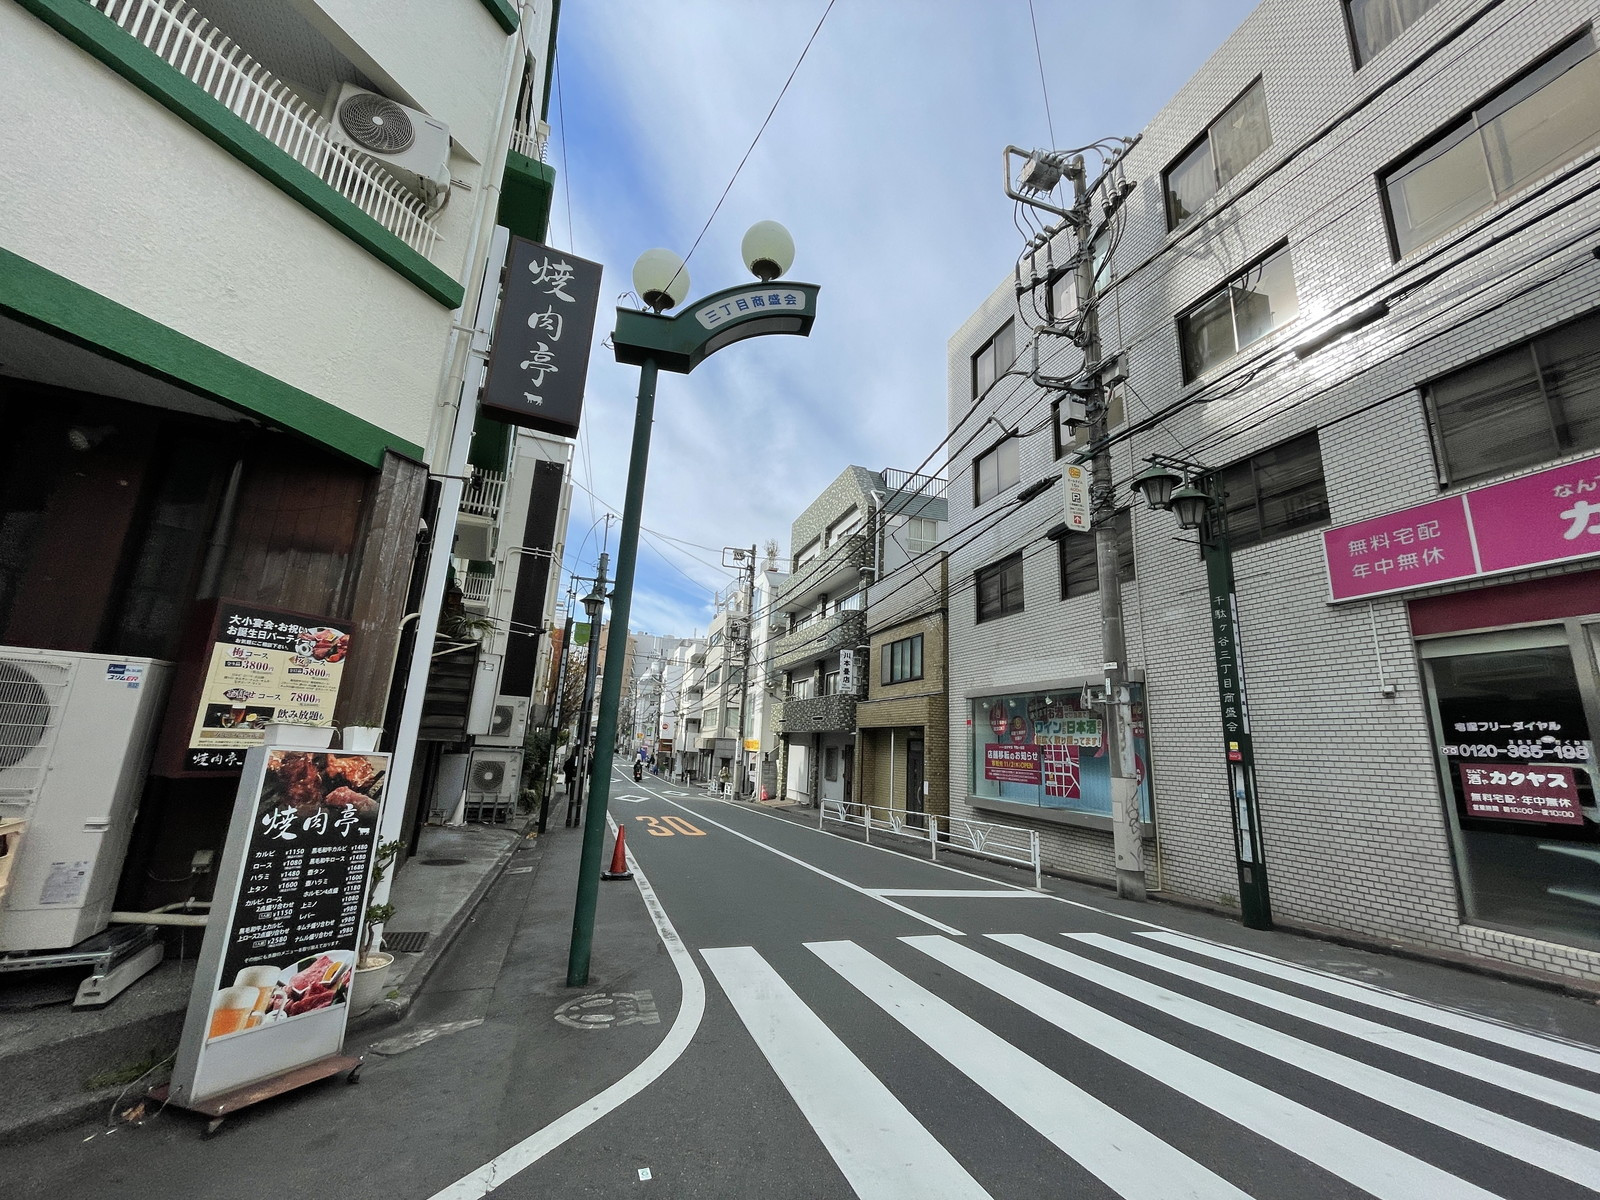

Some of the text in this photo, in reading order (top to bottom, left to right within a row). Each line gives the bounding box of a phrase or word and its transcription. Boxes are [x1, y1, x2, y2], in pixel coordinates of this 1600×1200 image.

[704, 293, 797, 324] 三丁目商盛会
[519, 256, 576, 388] 焼肉亭
[1347, 520, 1441, 557] 無料宅配
[1352, 546, 1446, 579] 年中無休
[1489, 771, 1568, 788] カクヤス
[262, 803, 360, 840] 焼肉亭
[636, 815, 707, 837] 30
[250, 873, 270, 881] ハラミ
[253, 862, 273, 870] ロース
[247, 885, 269, 894] 上タン
